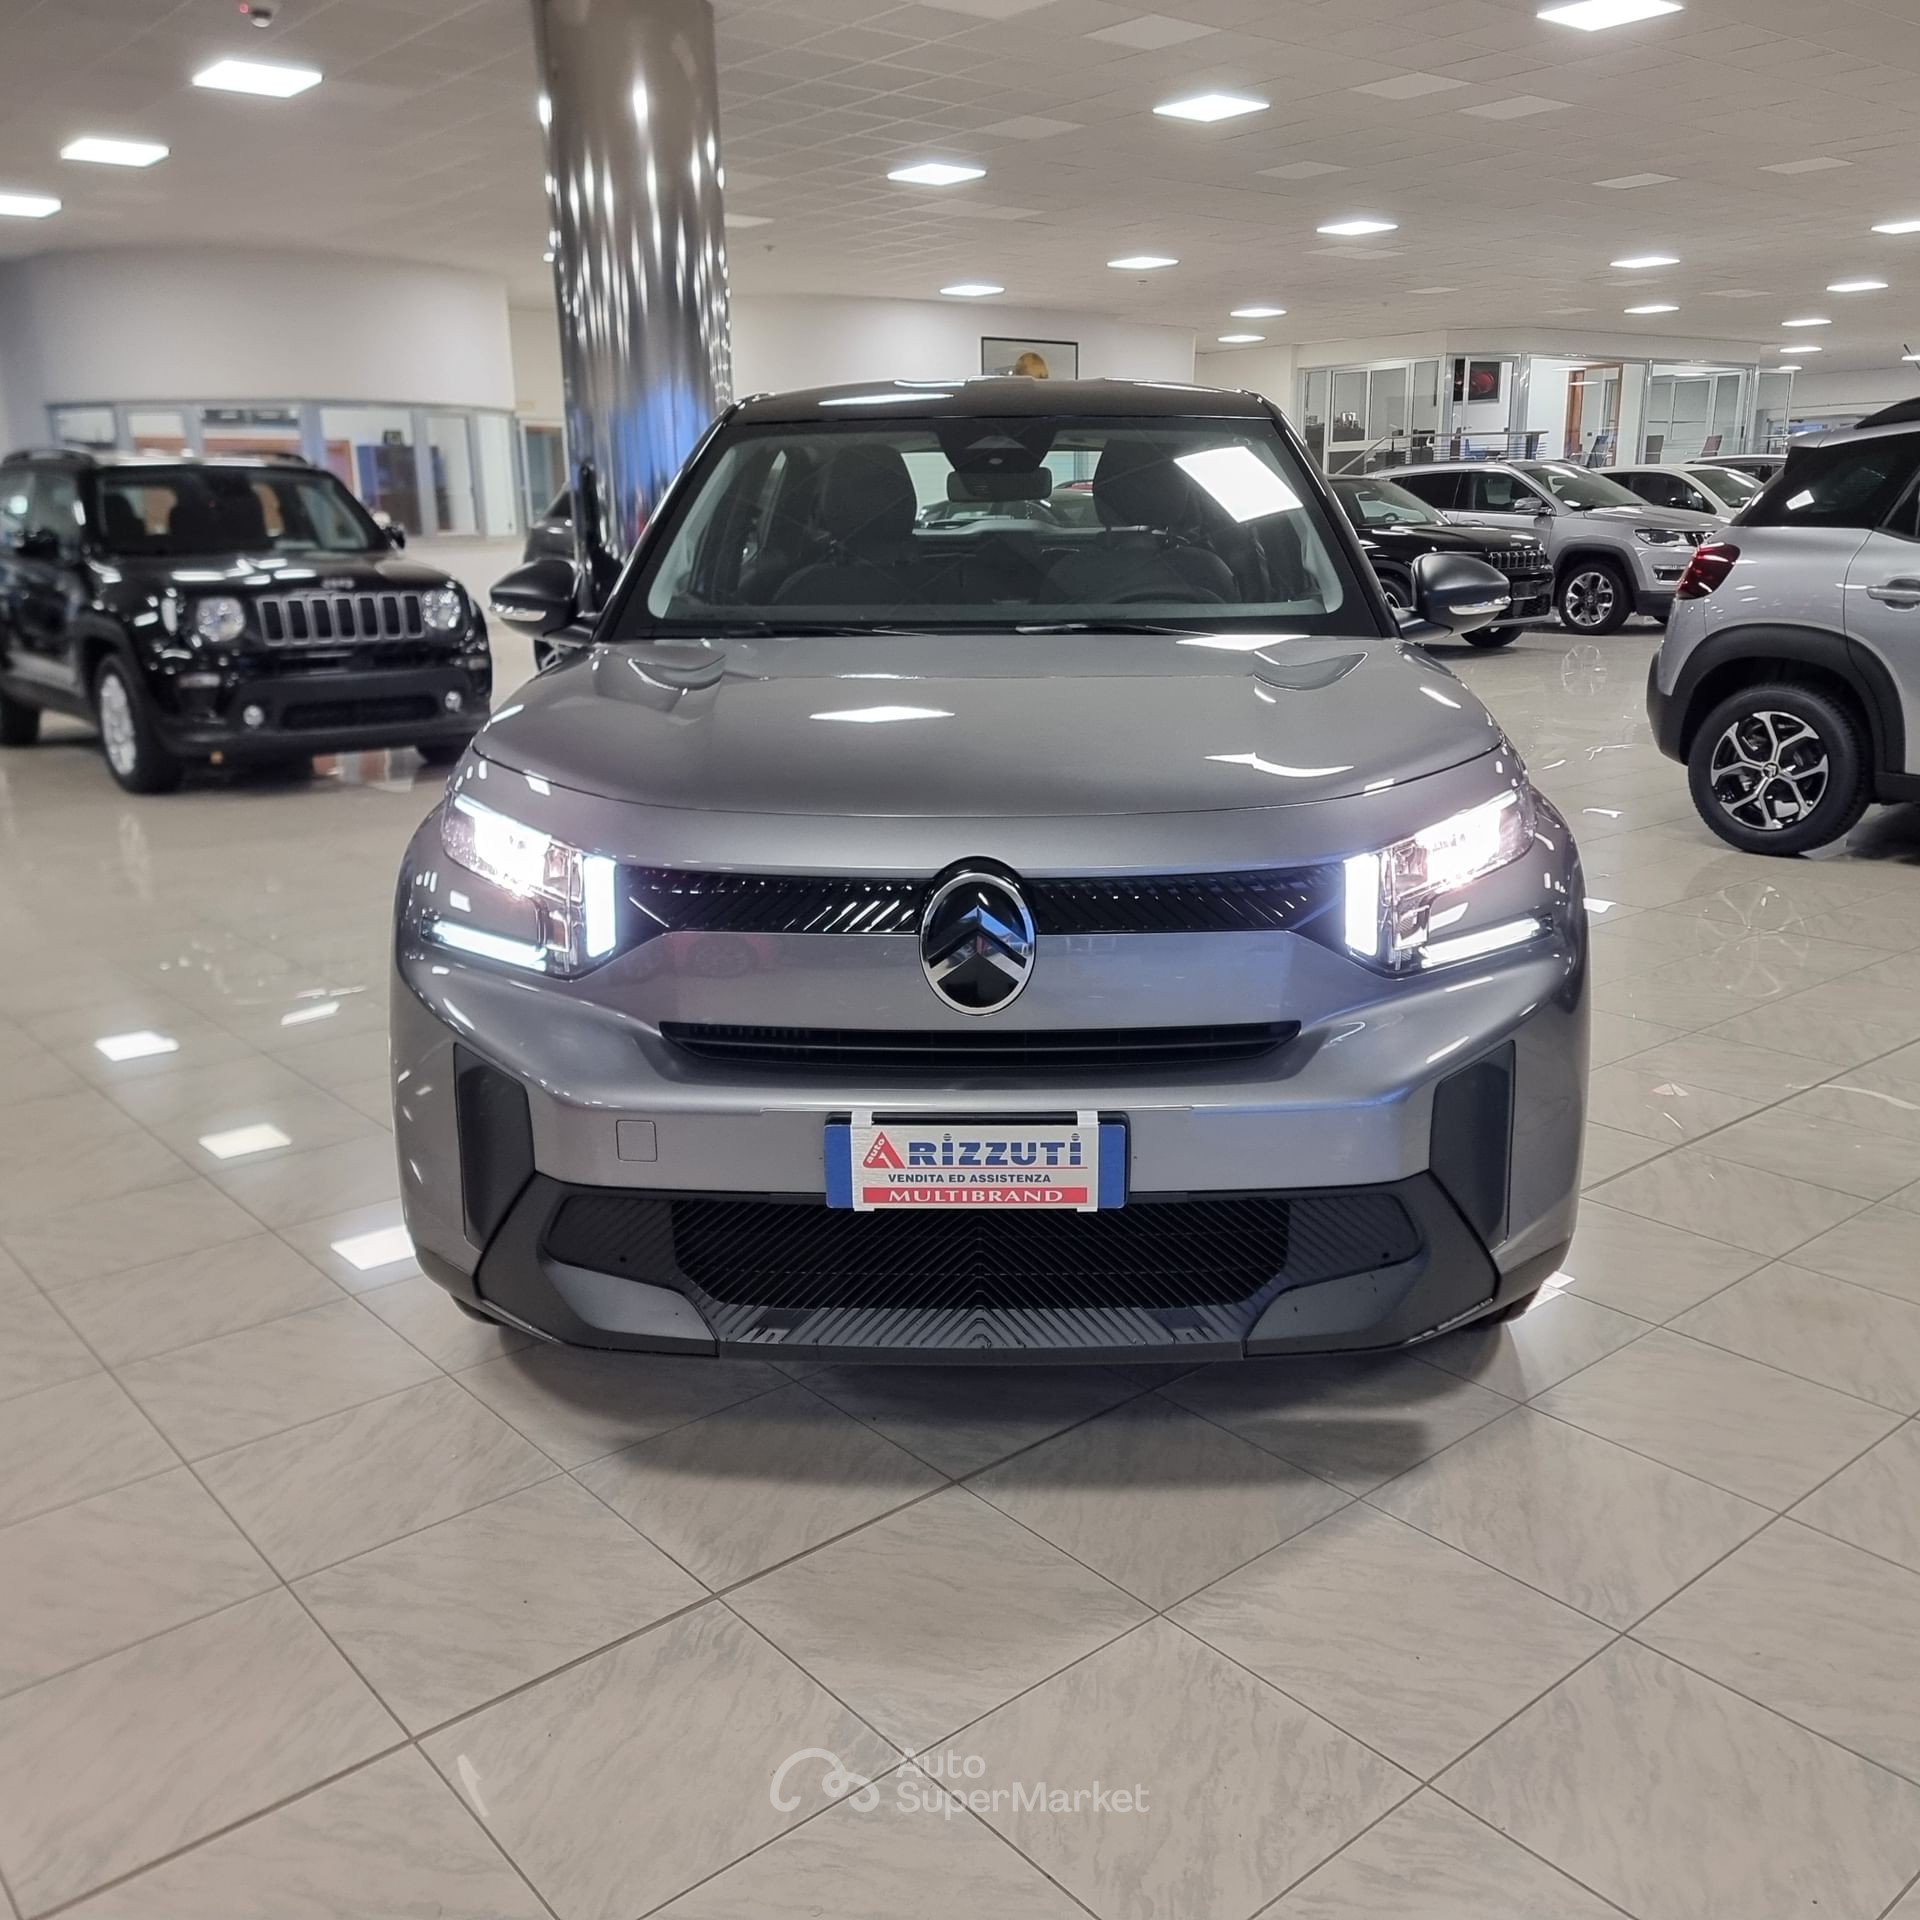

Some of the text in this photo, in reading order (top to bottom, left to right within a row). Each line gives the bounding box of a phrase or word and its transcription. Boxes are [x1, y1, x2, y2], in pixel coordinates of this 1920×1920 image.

[866, 1138, 885, 1164] auto
[888, 1174, 1051, 1183] VENDITA ED ASSISTENZA
[888, 1190, 1064, 1202] MULTIBRAND
